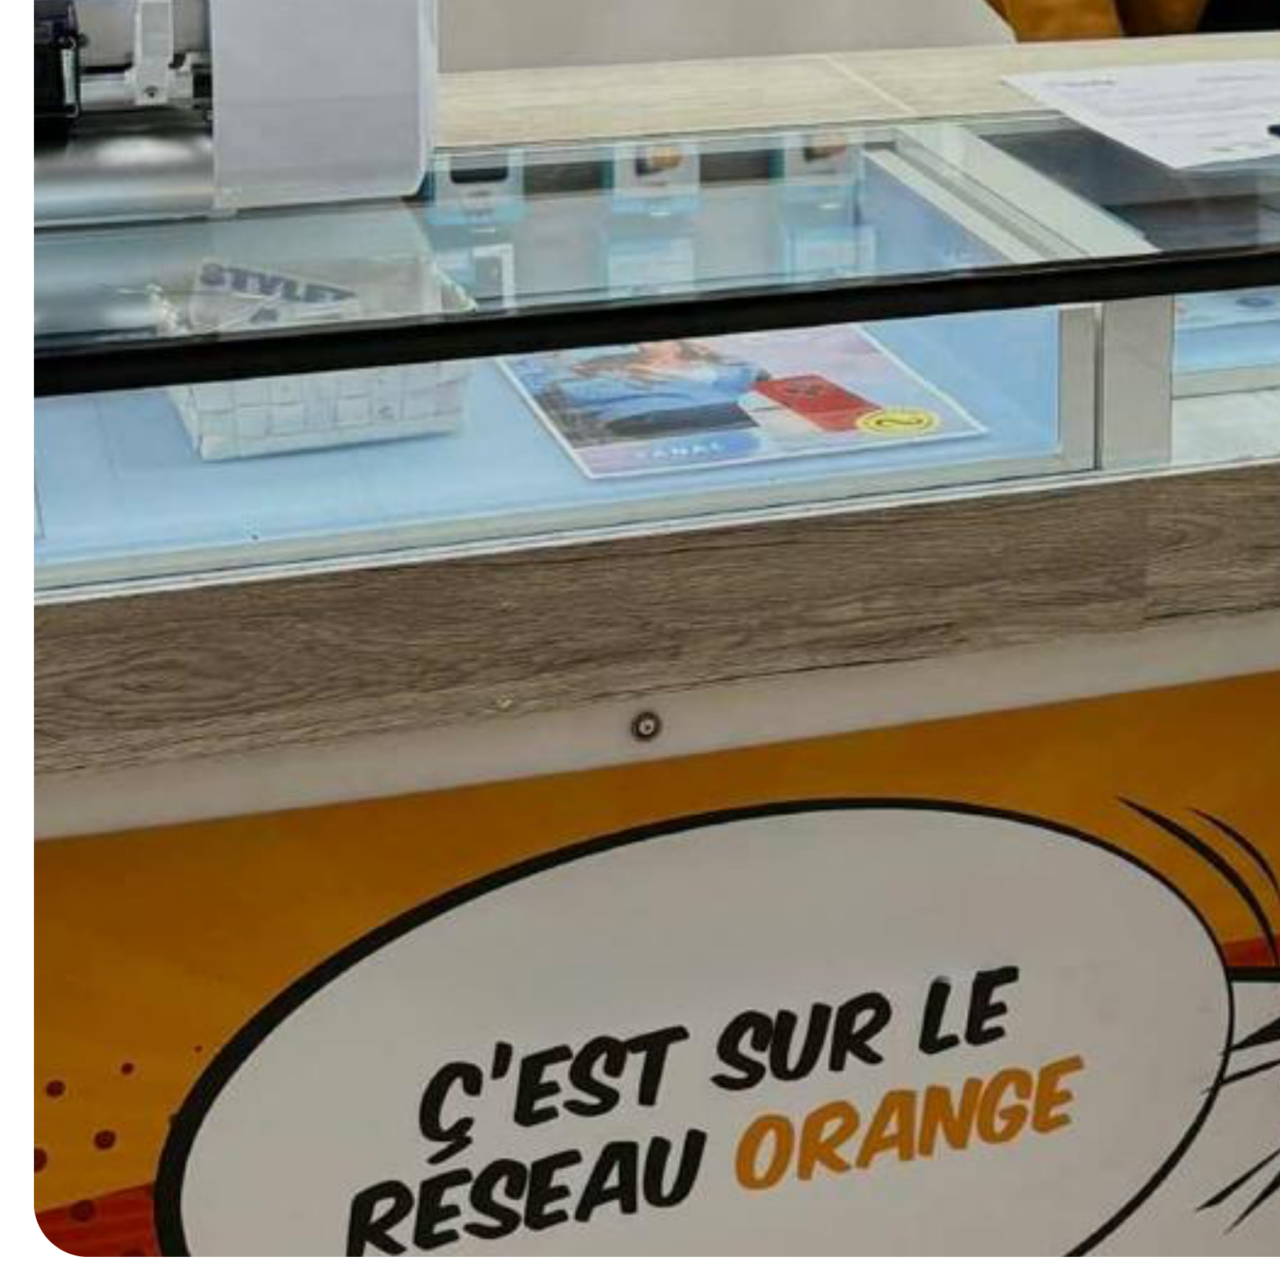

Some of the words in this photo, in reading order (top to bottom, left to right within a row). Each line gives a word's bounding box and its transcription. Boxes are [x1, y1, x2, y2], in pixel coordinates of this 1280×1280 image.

[711, 992, 892, 1091] SUR
[919, 966, 1020, 1055] LE
[346, 1128, 708, 1258] RÉSEAU
[735, 1055, 1084, 1191] ORANGE
